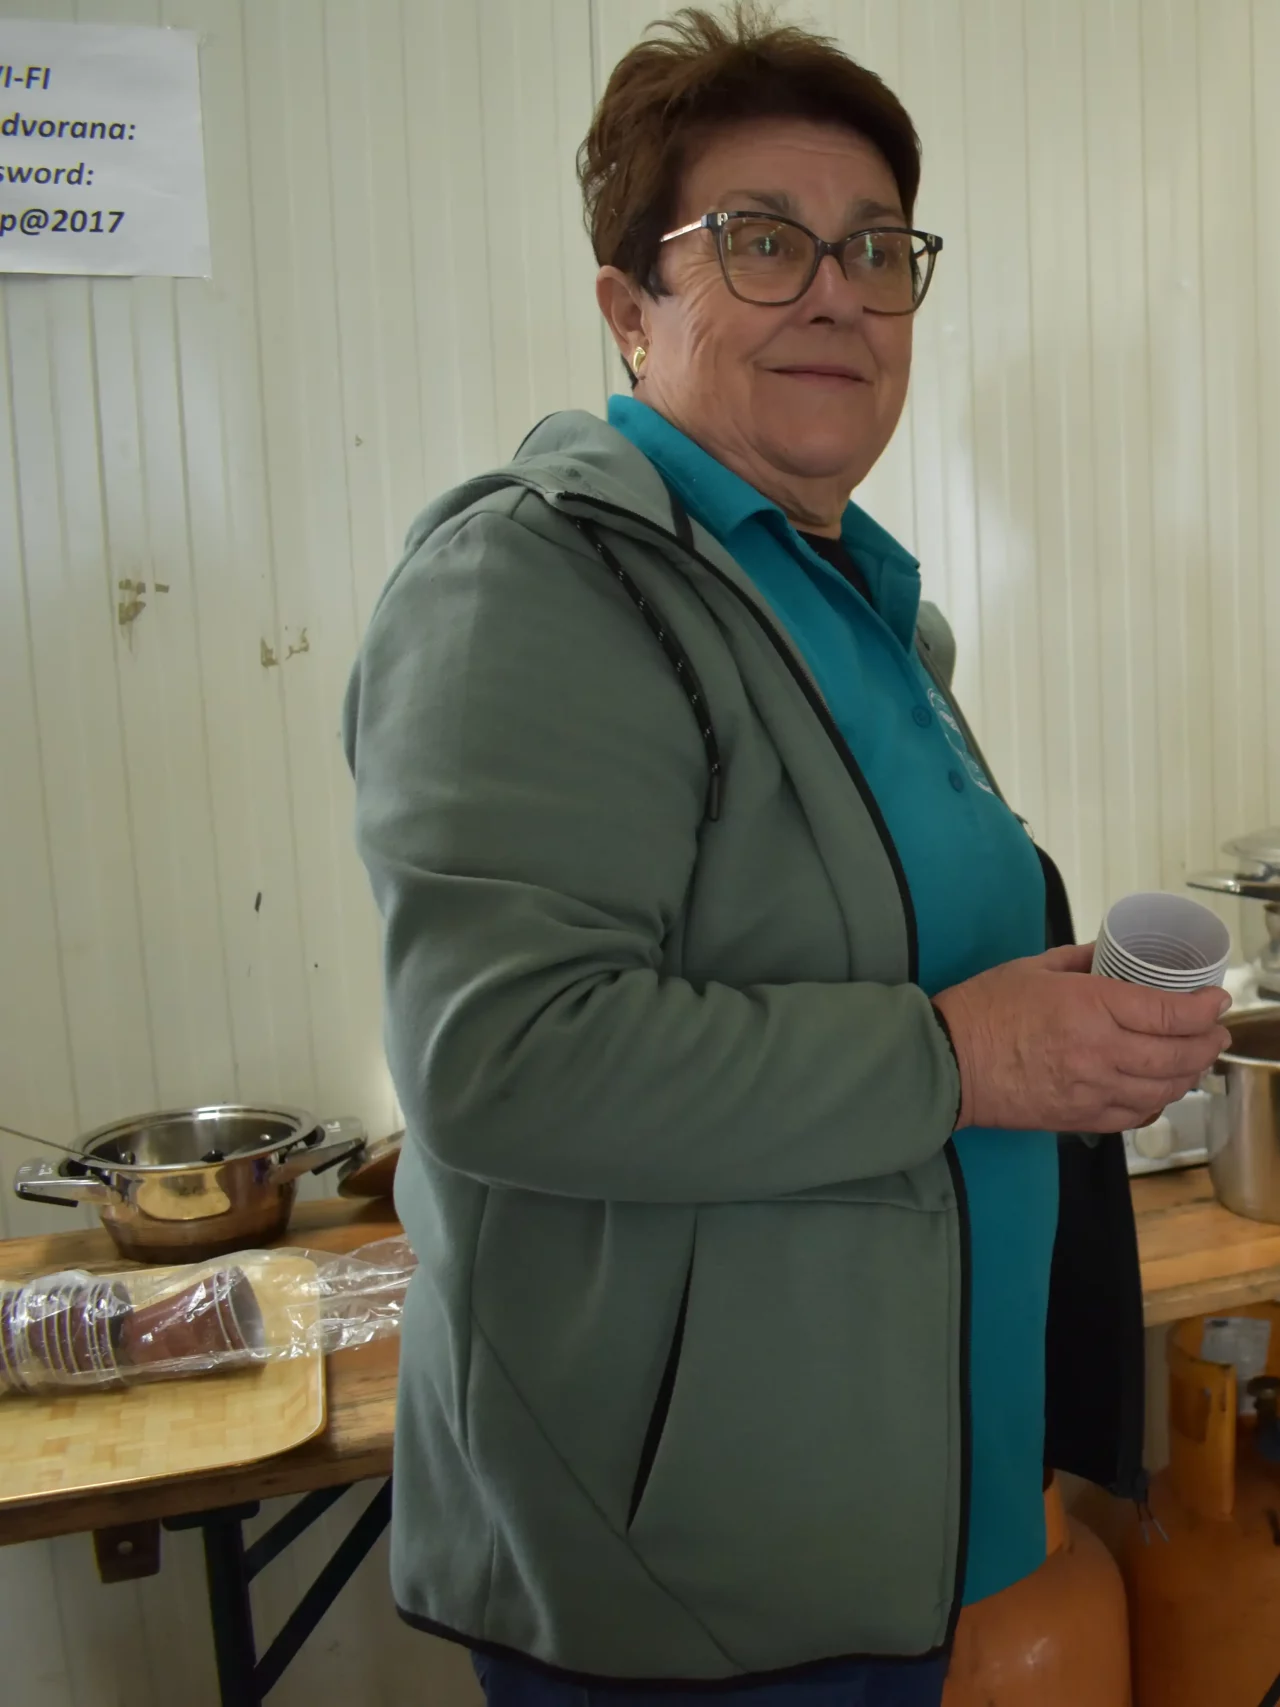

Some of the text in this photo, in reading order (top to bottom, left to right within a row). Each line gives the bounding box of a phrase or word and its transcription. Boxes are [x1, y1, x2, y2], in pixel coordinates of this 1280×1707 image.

[0, 65, 51, 90] I-FI
[1, 112, 136, 141] dvorana:
[0, 208, 125, 237] p@2017
